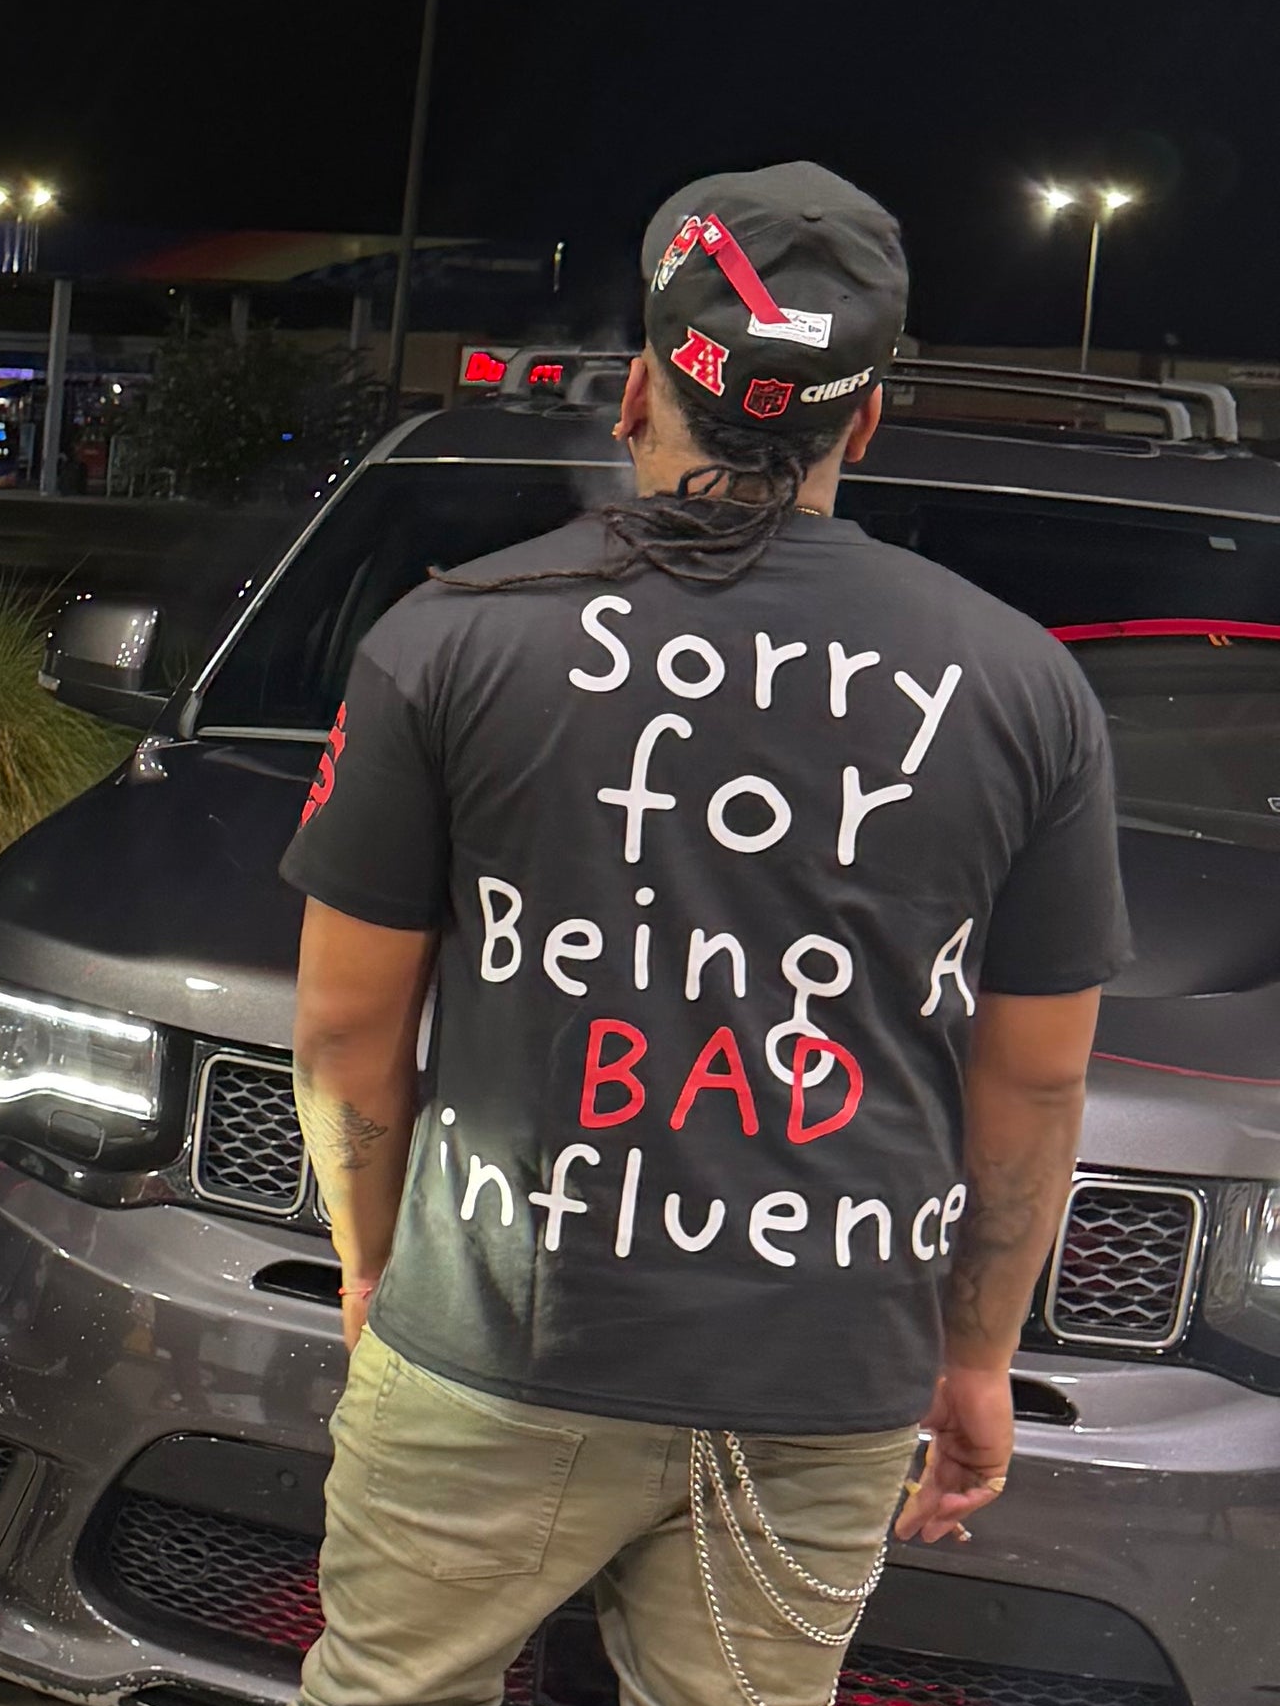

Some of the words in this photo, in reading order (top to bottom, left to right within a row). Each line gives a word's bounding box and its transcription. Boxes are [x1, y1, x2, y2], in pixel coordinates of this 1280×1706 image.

[800, 366, 875, 403] CHIEFS
[569, 595, 963, 775] Sorry
[597, 713, 913, 866] for
[477, 876, 854, 1089] Being
[921, 918, 975, 1018] A
[579, 1018, 864, 1145] BAD
